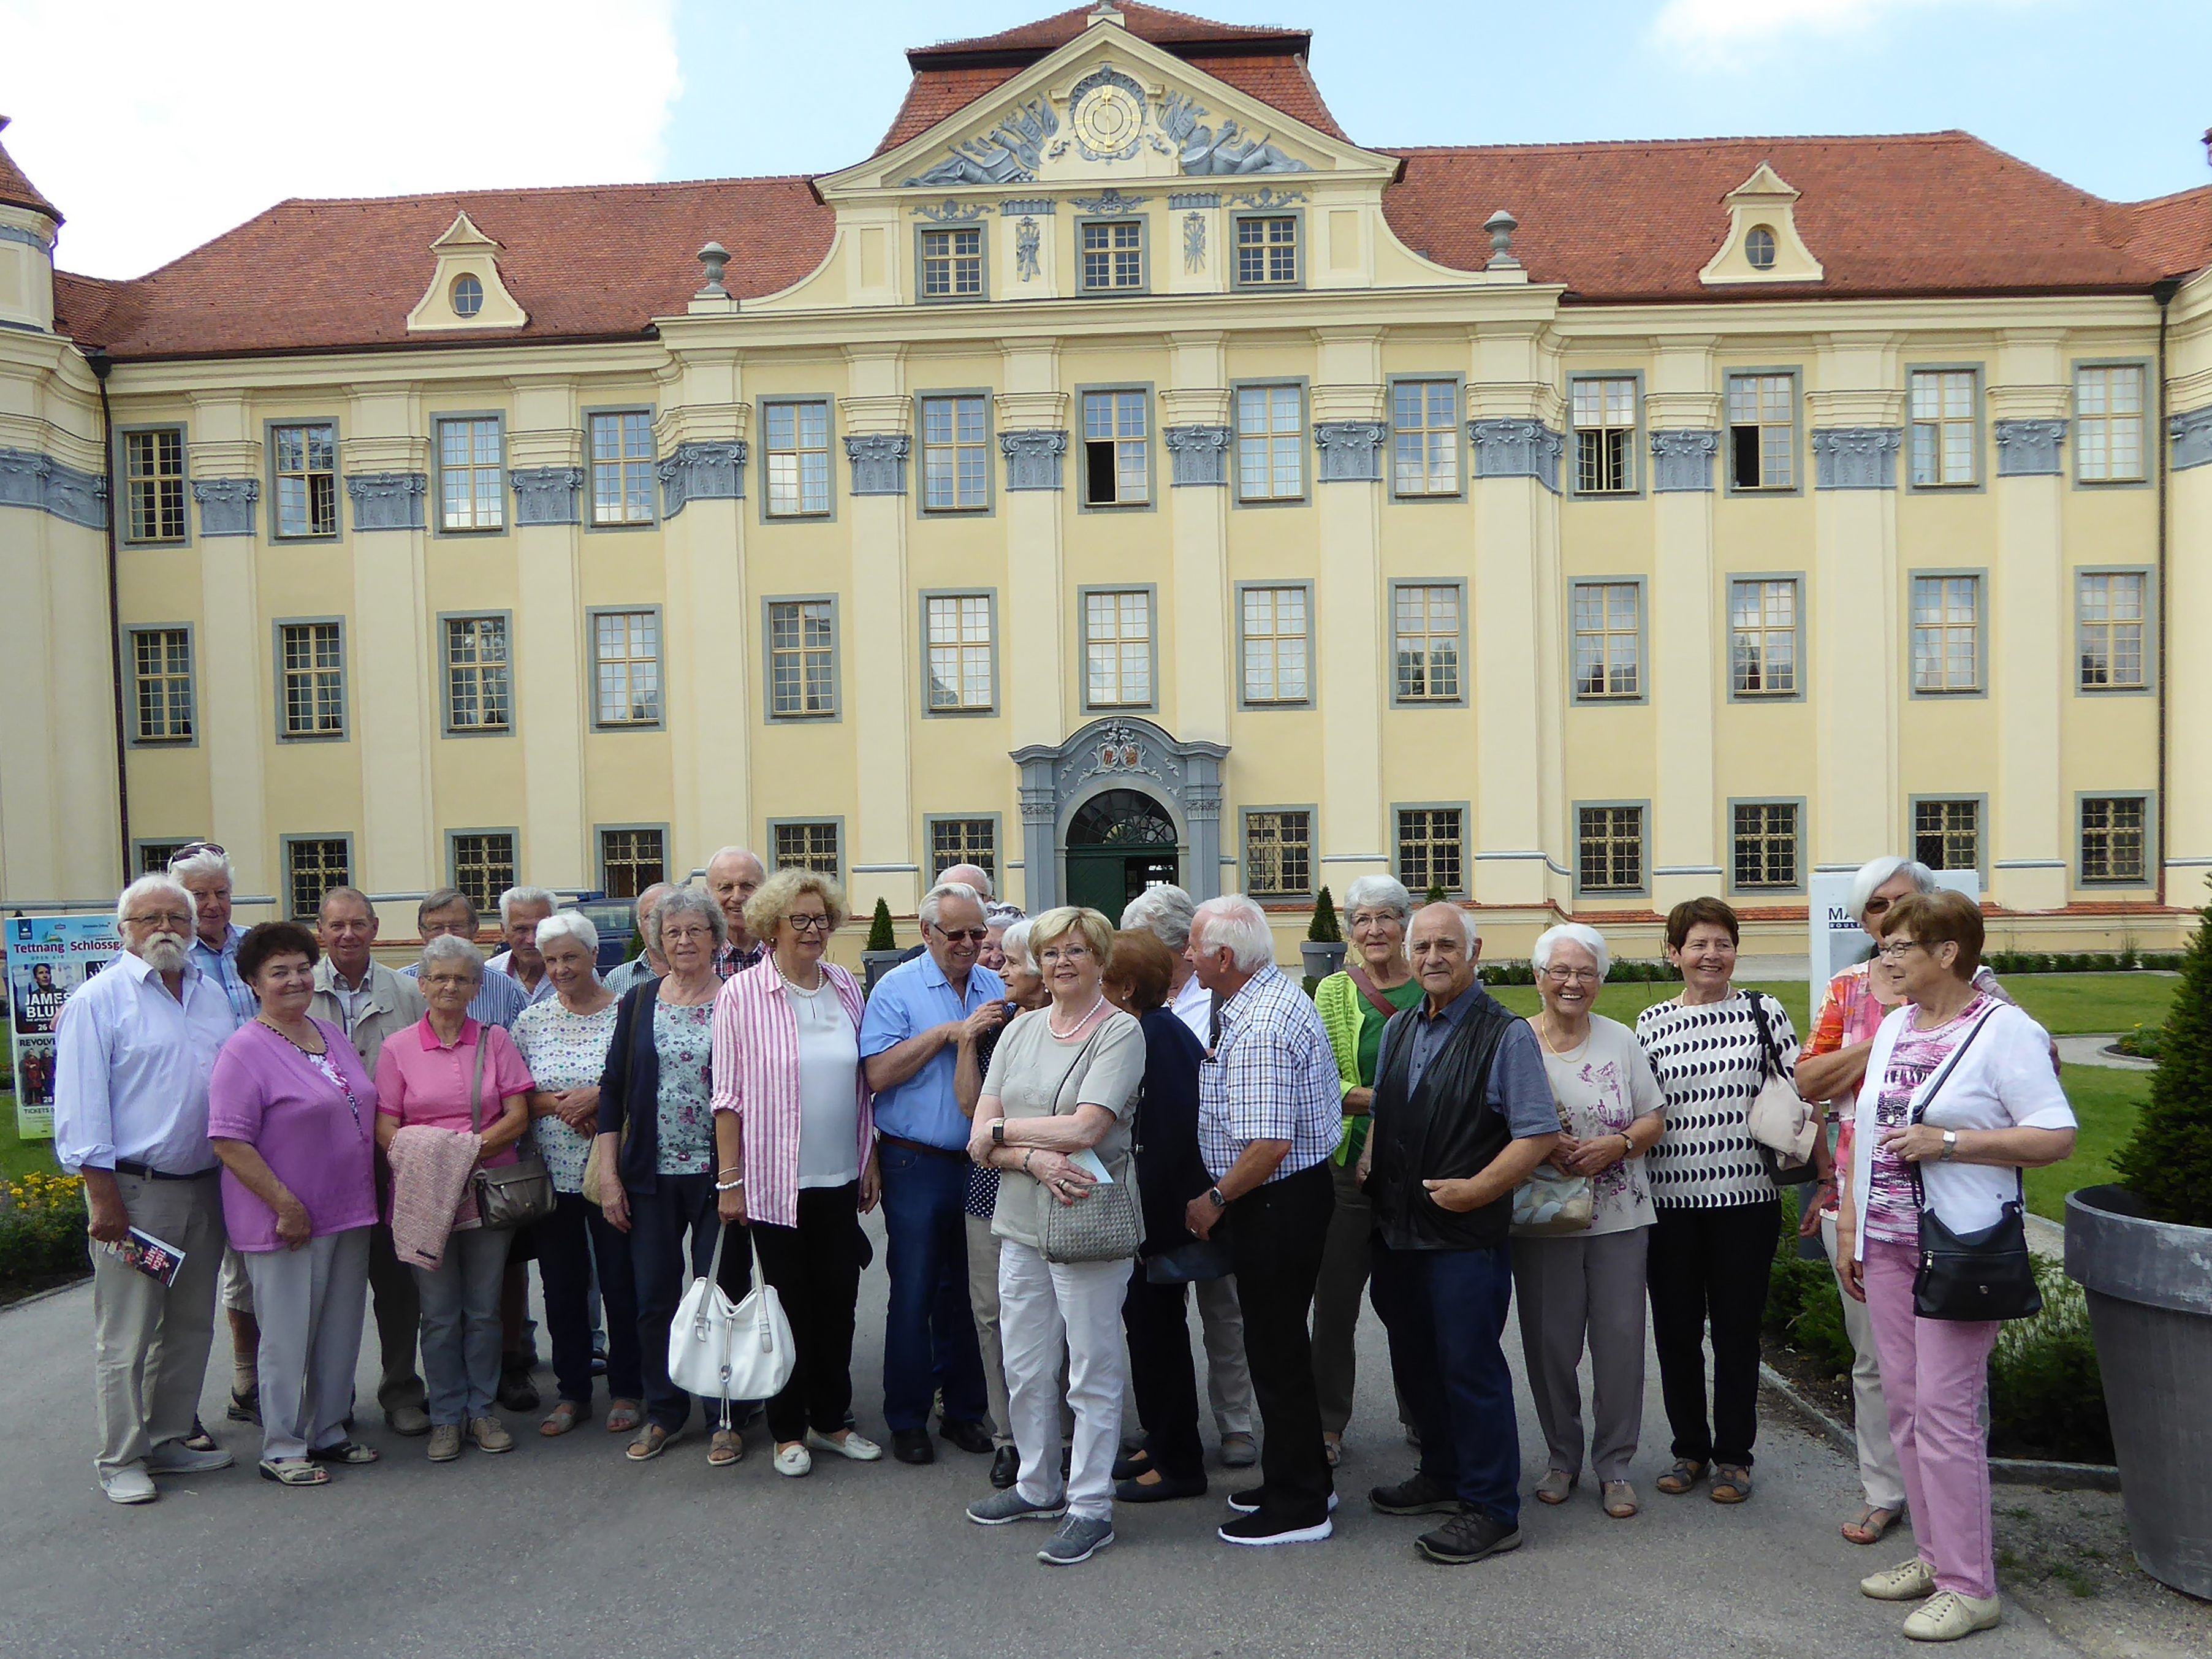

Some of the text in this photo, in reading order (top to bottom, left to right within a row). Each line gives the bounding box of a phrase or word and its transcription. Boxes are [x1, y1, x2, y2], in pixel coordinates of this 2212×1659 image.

[13, 943, 65, 954] Tettnang
[25, 992, 70, 1006] JAMES
[26, 1006, 59, 1018] BLU
[145, 1245, 158, 1264] TAFEL
[151, 1250, 167, 1270] TISCH
